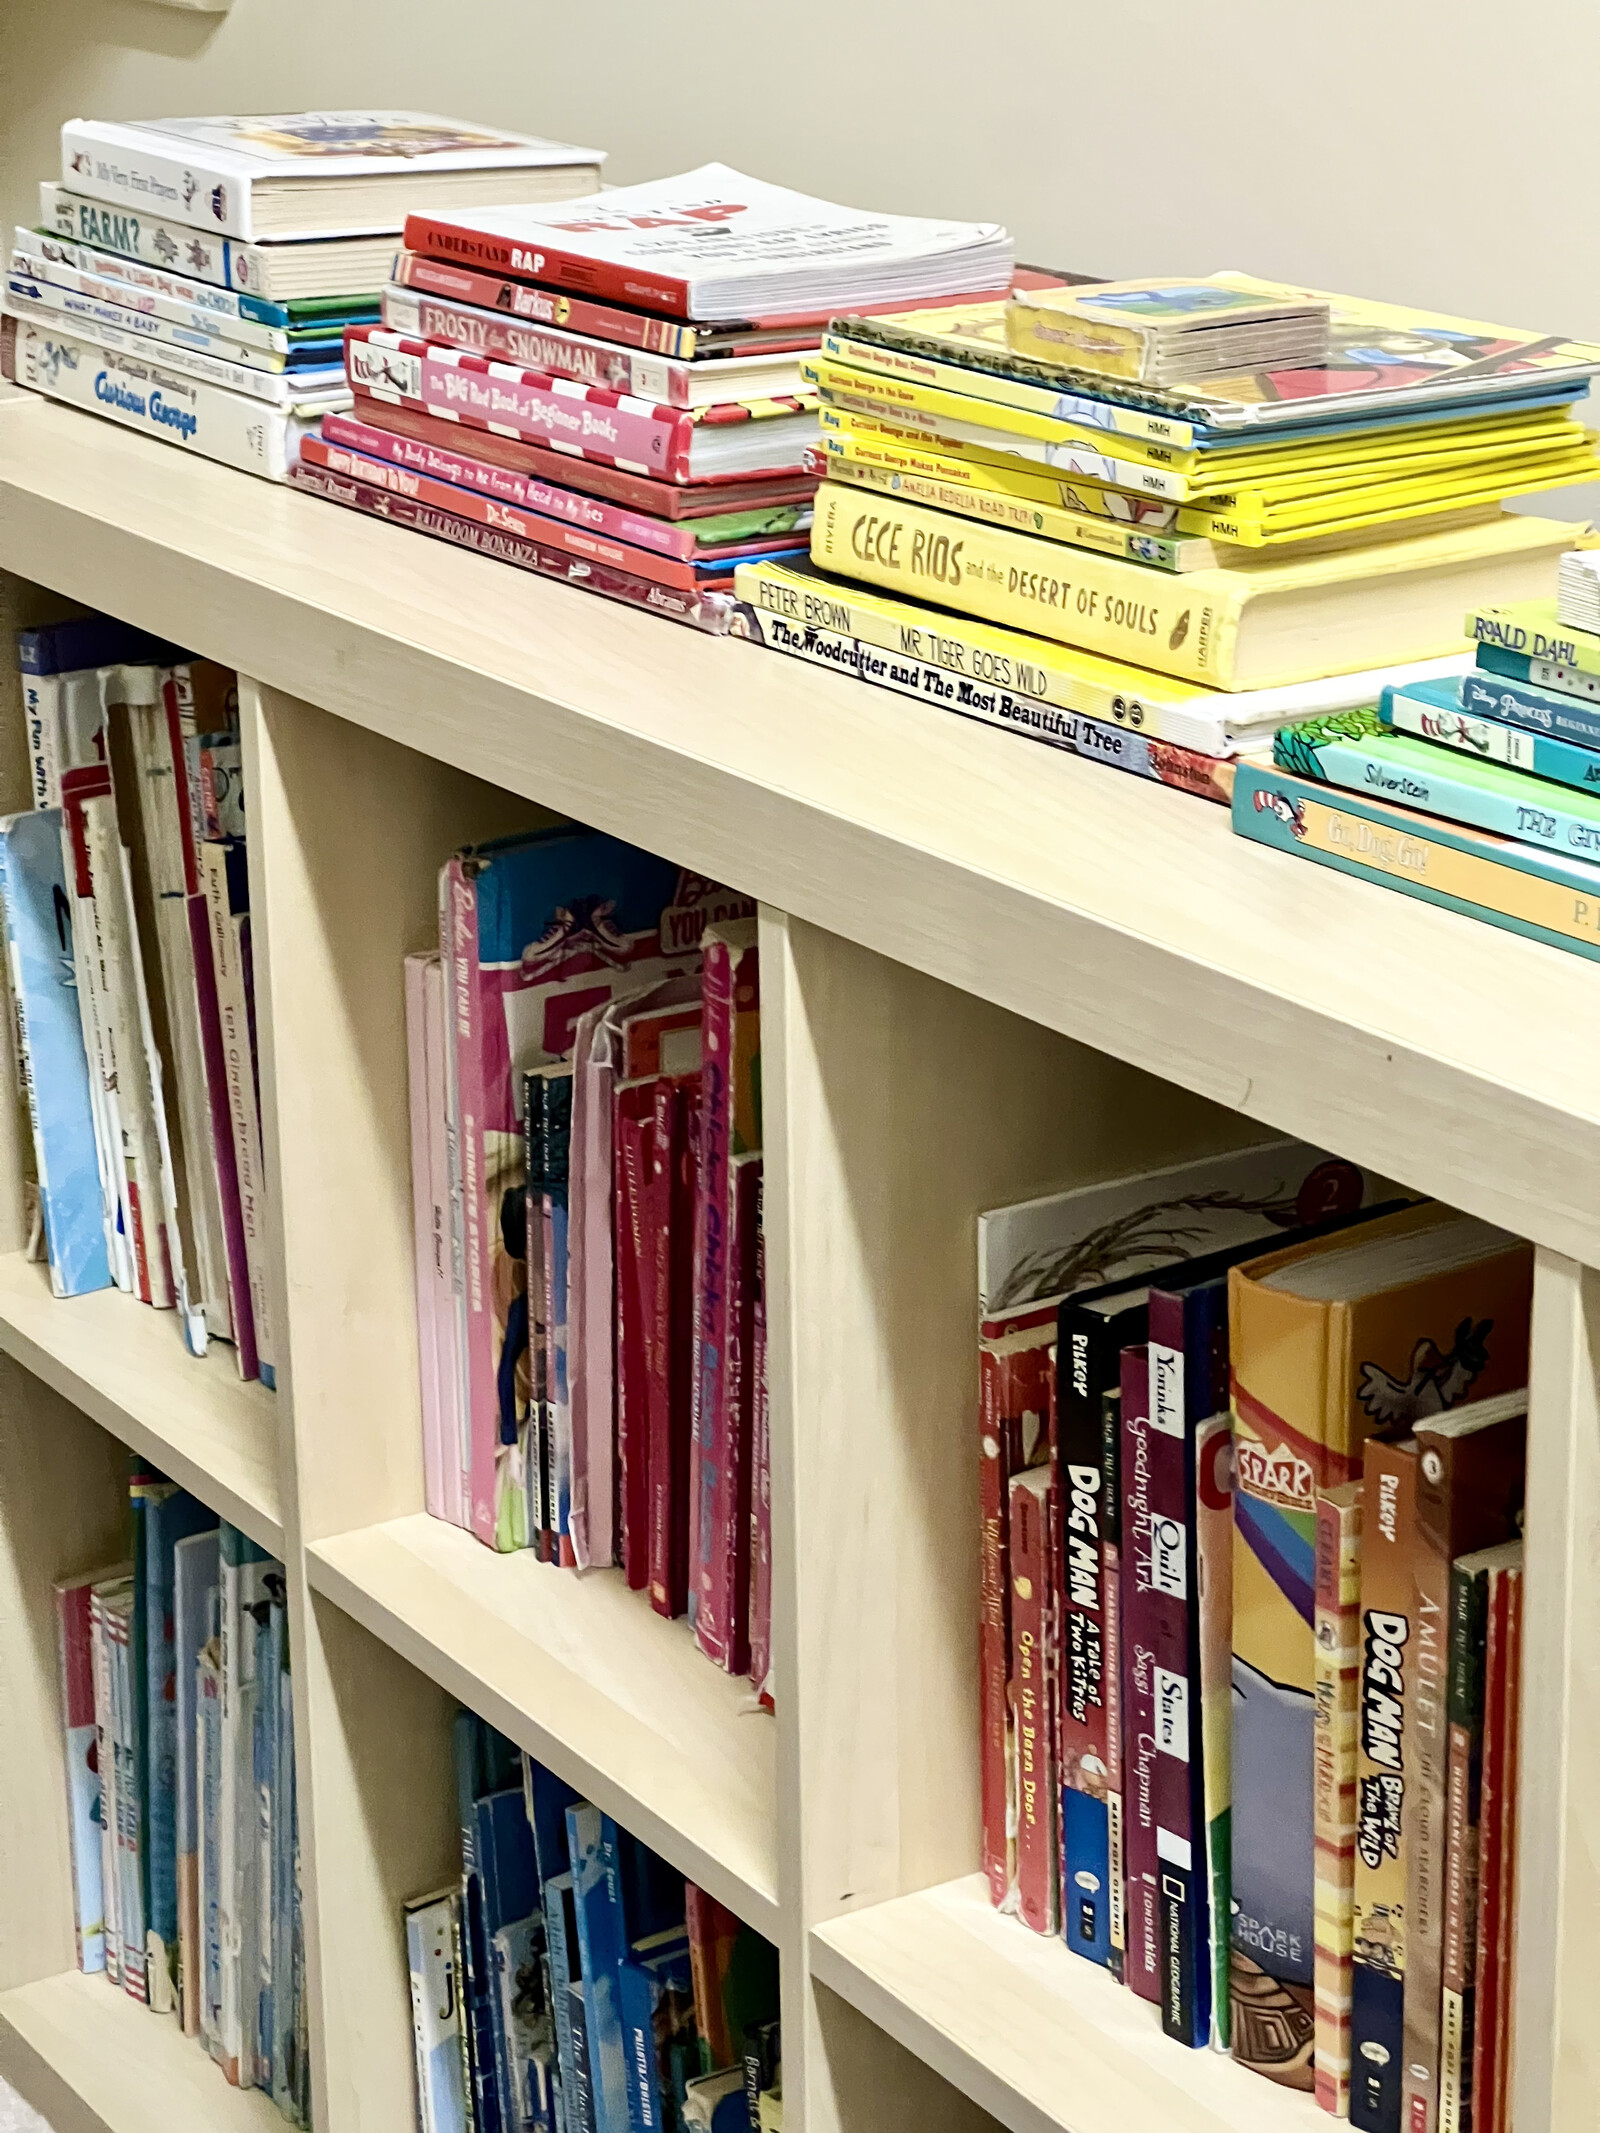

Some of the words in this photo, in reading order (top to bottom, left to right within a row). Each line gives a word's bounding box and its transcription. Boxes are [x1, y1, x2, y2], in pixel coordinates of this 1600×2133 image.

[79, 205, 140, 252] FARM?
[535, 204, 748, 233] RAP
[427, 231, 509, 264] UNDERSTAND
[511, 248, 545, 274] RAP
[133, 315, 161, 333] BABY
[513, 286, 554, 320] Barkus
[425, 306, 488, 347] FROSTY
[507, 329, 597, 378] SNOWMAN
[94, 371, 146, 416] Curious
[149, 390, 197, 440] George
[491, 388, 519, 415] Book
[531, 398, 582, 431] Beginner
[582, 410, 619, 443] Books
[1147, 420, 1170, 437] HMH
[1147, 448, 1172, 463] HMH
[405, 444, 426, 468] Body
[428, 451, 462, 482] Belongs
[476, 468, 489, 485] Me
[491, 470, 512, 491] from
[582, 500, 604, 523] Toes
[1142, 475, 1166, 491] HMH
[415, 508, 480, 547] BALLROOM
[480, 530, 539, 567] BONANZA
[485, 503, 501, 525] Dr.
[500, 505, 527, 537] Seuss
[826, 500, 838, 554] RIVERA
[1212, 520, 1239, 538] HMH
[852, 513, 903, 568] CECE
[911, 528, 965, 587] RIOS
[965, 559, 985, 580] and
[986, 563, 1004, 586] the
[1008, 566, 1072, 606] DESERT
[1076, 587, 1099, 617] OF
[1105, 595, 1159, 637] SOULS
[760, 580, 799, 620] PETER
[804, 594, 851, 633] BROWN
[900, 624, 922, 658] MR
[929, 634, 965, 671] TIGER
[972, 641, 1011, 686] GOES
[1015, 663, 1048, 697] WILD
[1197, 606, 1213, 668] HARPER
[1473, 616, 1526, 652] ROALD
[1533, 633, 1579, 667] DAHL
[26, 688, 38, 717] My
[772, 619, 799, 647] The
[803, 625, 888, 678] Woodcutter
[890, 664, 920, 688] and
[923, 670, 954, 699] The
[957, 681, 996, 715] Most
[999, 695, 1079, 742] Beautiful
[1082, 721, 1123, 755] Tree
[31, 719, 42, 752] Fun
[1364, 763, 1430, 802] Silverstein
[1517, 806, 1556, 839] THE
[668, 908, 708, 948] YOU
[1573, 899, 1589, 926] P.
[228, 1045, 254, 1193] Gingerbread
[241, 1195, 256, 1238] Men
[464, 1114, 478, 1219] 5-MINUTE
[469, 1221, 483, 1313] STORIES
[1071, 1333, 1089, 1399] PILKEY
[1155, 1352, 1175, 1428] Yorinks
[1126, 1416, 1153, 1541] Goodnight
[1238, 1448, 1312, 1498] SPARK
[1067, 1463, 1101, 1539] DOG
[1378, 1473, 1400, 1544] PILKEY
[1067, 1535, 1101, 1611] MAN
[1134, 1546, 1154, 1594] Ark
[1153, 1519, 1182, 1590] Quilt
[1019, 1630, 1034, 1680] Open
[1134, 1644, 1155, 1697] Sassi
[1367, 1610, 1409, 1694] DOG
[1416, 1592, 1442, 1739] AMULET
[1022, 1687, 1036, 1721] the
[1160, 1674, 1183, 1746] States
[1366, 1685, 1405, 1771] MAN
[1023, 1724, 1036, 1774] Barn
[1133, 1732, 1157, 1829] Chapman
[1379, 1775, 1404, 1834] BRAWL
[1111, 1801, 1119, 1837] MARY
[1418, 1785, 1431, 1842] CLOUD
[1452, 1765, 1463, 1851] HURRICANE
[601, 1841, 613, 1863] Dr.
[604, 1866, 617, 1905] Seuss
[1417, 1845, 1430, 1936] SEARCHERS
[1169, 1900, 1180, 1956] NATIONAL
[1237, 1929, 1304, 1963] HOUSE
[1239, 1912, 1302, 1951] SPARK
[1169, 1955, 1182, 2028] GEOGRAPHIC
[1448, 1999, 1456, 2036] MARY
[571, 2026, 584, 2060] The
[1446, 2042, 1455, 2076] POPE
